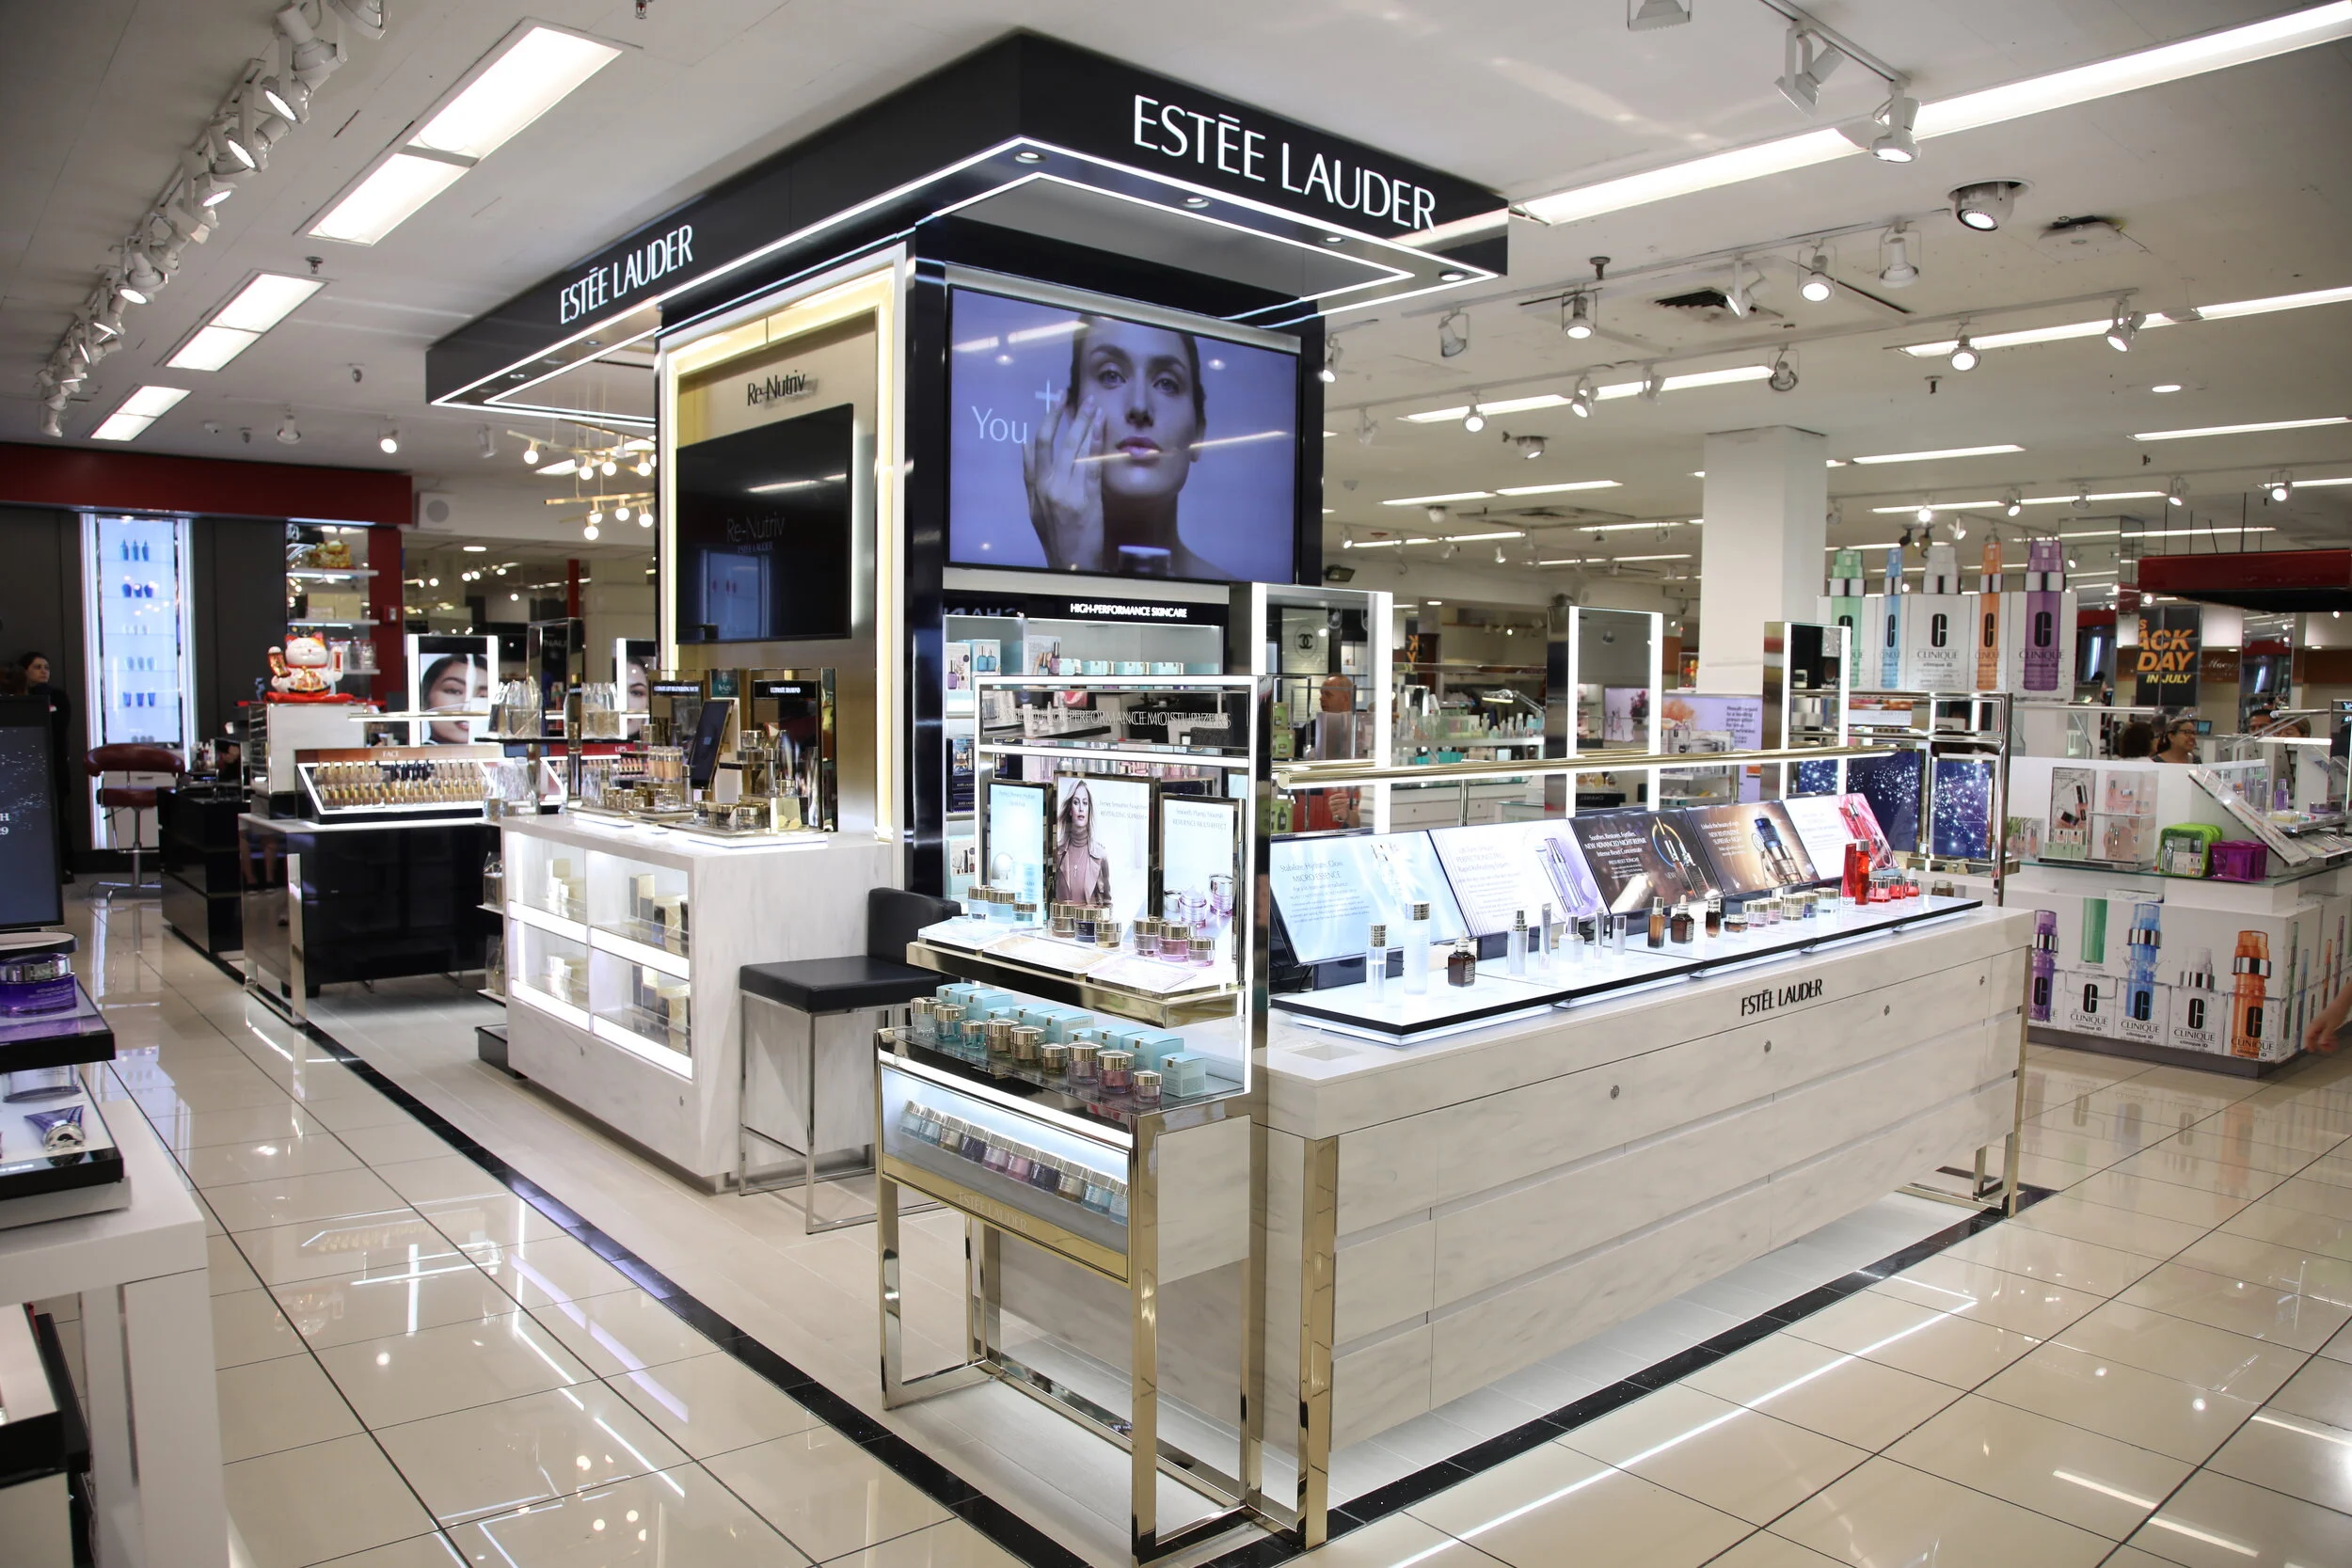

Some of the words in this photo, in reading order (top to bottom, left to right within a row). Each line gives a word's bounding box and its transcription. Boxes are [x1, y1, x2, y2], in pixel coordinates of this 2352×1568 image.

[1281, 142, 1436, 234] LAUDER
[613, 224, 693, 299] LAUDER
[747, 370, 806, 406] Re-Nutriv
[971, 405, 1028, 445] You
[1070, 603, 1151, 616] HIGH-PERFORMANCE
[1152, 607, 1187, 618] SKINCARE
[1931, 613, 1947, 647] C
[2034, 611, 2052, 647] C
[1917, 651, 1958, 660] CLINIQUE
[2019, 650, 2065, 660] CLINIQUE
[2137, 652, 2195, 671] DAY
[2146, 674, 2159, 684] IN
[2162, 674, 2191, 684] JULY
[1597, 840, 1618, 848] ADVANCED
[1293, 873, 1314, 882] MICRO
[1315, 871, 1341, 880] ESSENCE
[1778, 978, 1822, 1006] LAUDER
[2083, 983, 2098, 1013] C
[2134, 990, 2150, 1021] C
[2187, 998, 2204, 1029] C
[2070, 1013, 2108, 1026] CLINIQUE
[2121, 1021, 2160, 1034] CLINIQUE
[2174, 1029, 2216, 1042] CLINIQUE
[2231, 1037, 2273, 1052] CLINIQUE
[988, 1203, 1027, 1233] LAUDER
